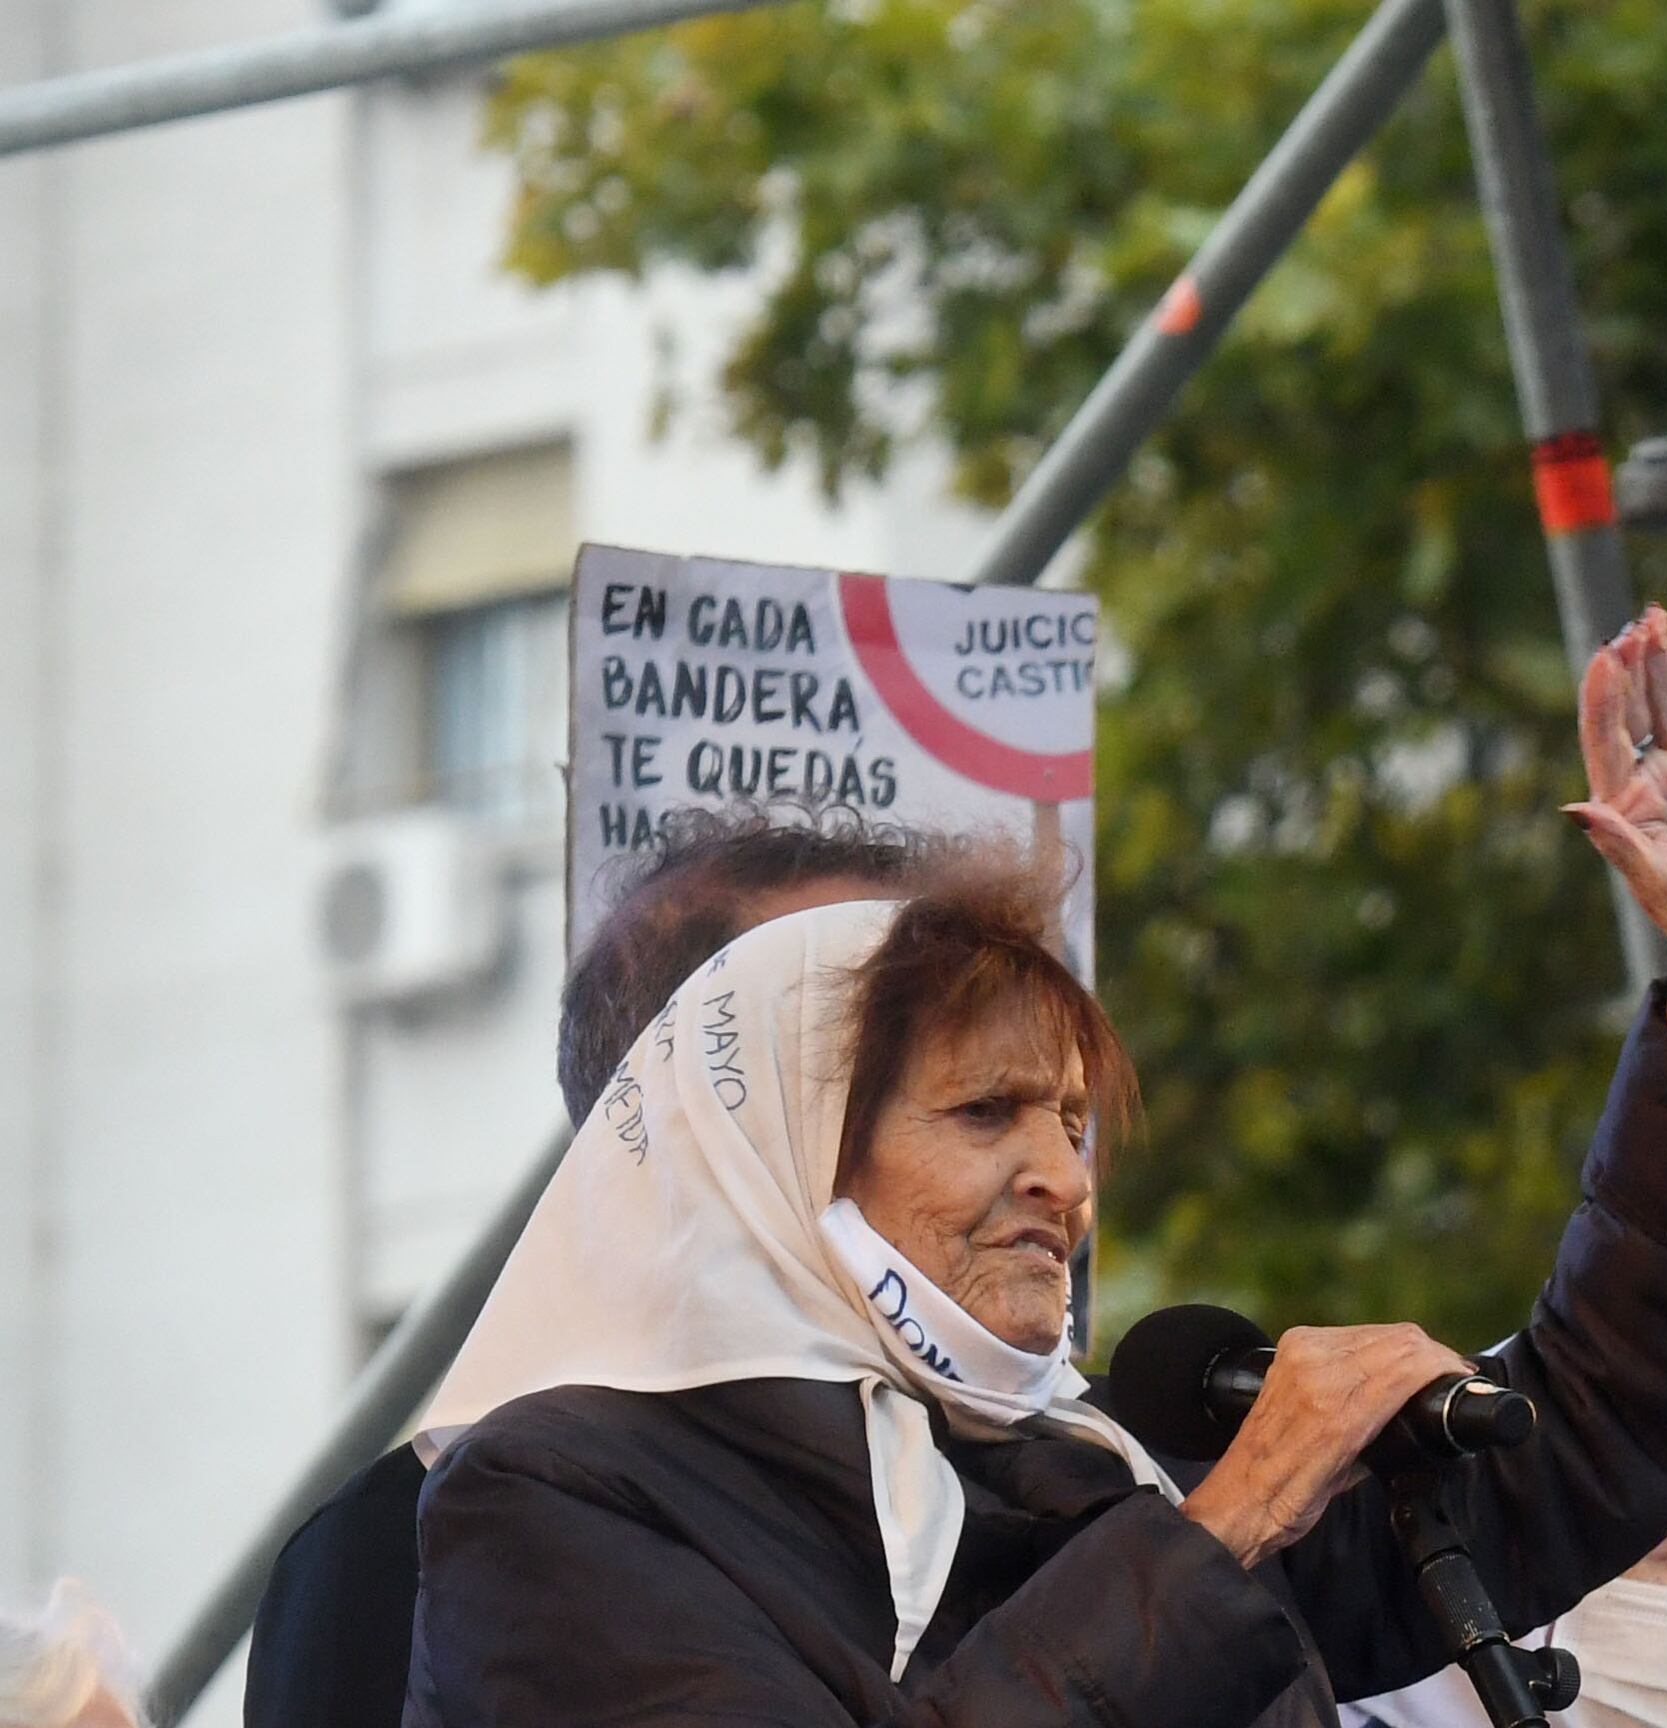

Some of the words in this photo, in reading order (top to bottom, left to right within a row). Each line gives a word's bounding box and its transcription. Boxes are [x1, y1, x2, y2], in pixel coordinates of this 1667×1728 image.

[602, 583, 666, 637] EN
[687, 594, 817, 654] CADA
[602, 655, 860, 733] BANDERA
[603, 733, 663, 787] TE
[687, 736, 897, 806] QUEDÁS
[599, 801, 660, 851] HA
[702, 990, 748, 1112] MAYO
[867, 1267, 966, 1385] DON
